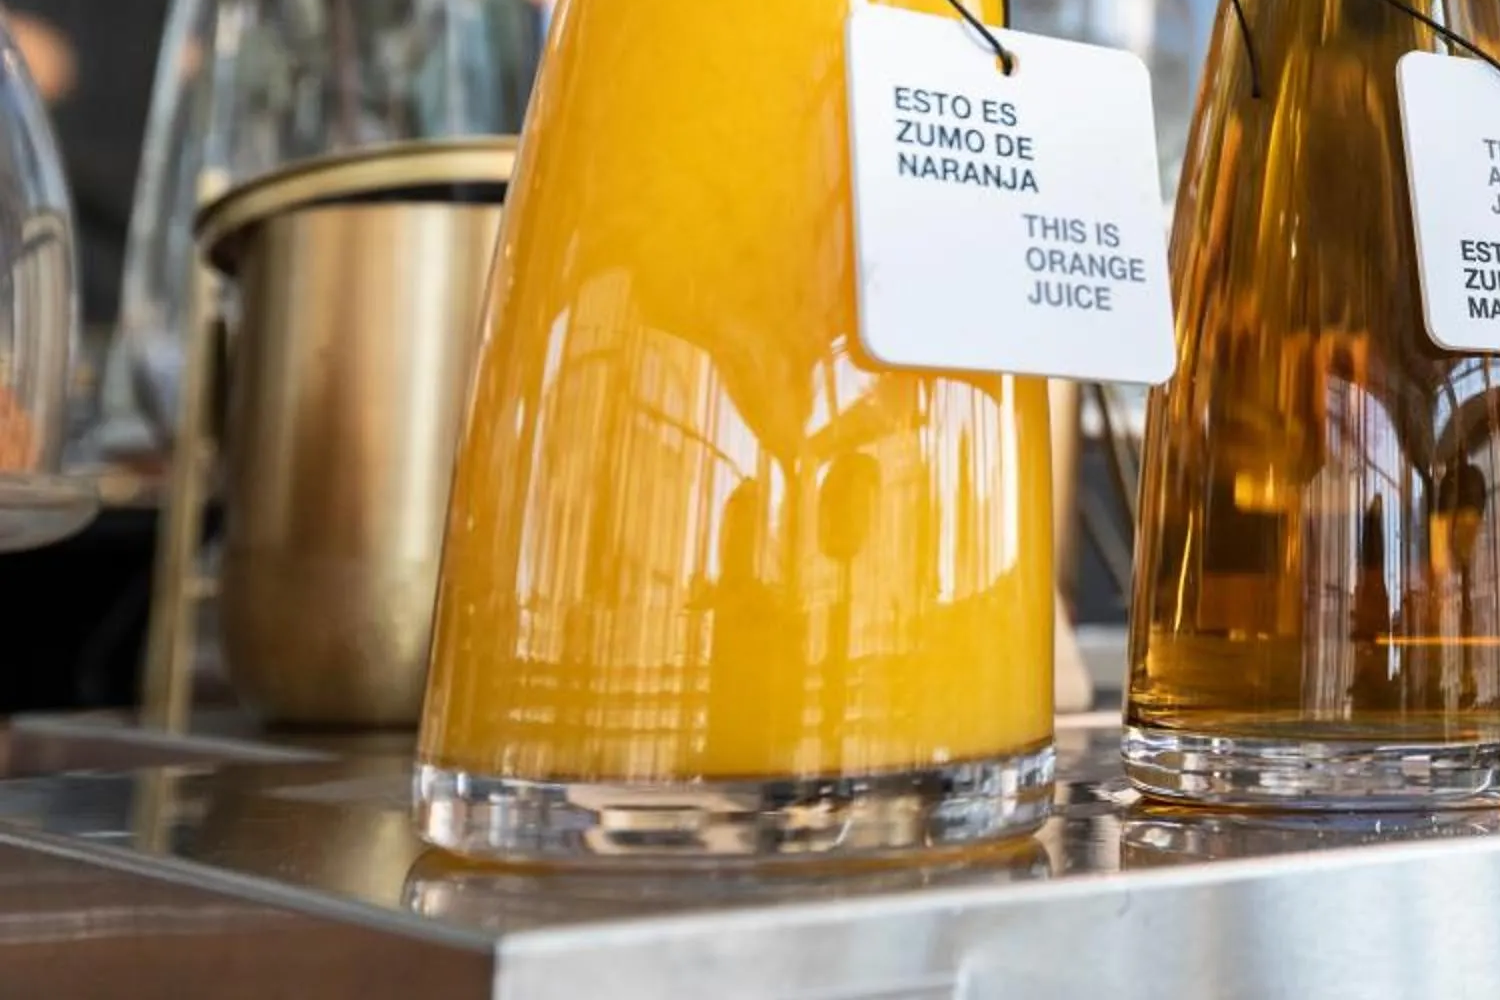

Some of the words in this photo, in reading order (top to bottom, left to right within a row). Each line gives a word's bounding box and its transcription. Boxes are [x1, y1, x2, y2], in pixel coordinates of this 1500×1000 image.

[894, 86, 972, 119] ESTO
[982, 99, 1017, 126] ES
[895, 119, 985, 154] ZUMO
[995, 133, 1035, 160] DE
[897, 152, 1040, 193] NARANJA
[1022, 213, 1087, 244] THIS
[1096, 223, 1120, 247] IS
[1025, 246, 1147, 282] ORANGE
[1027, 281, 1112, 311] JUICE
